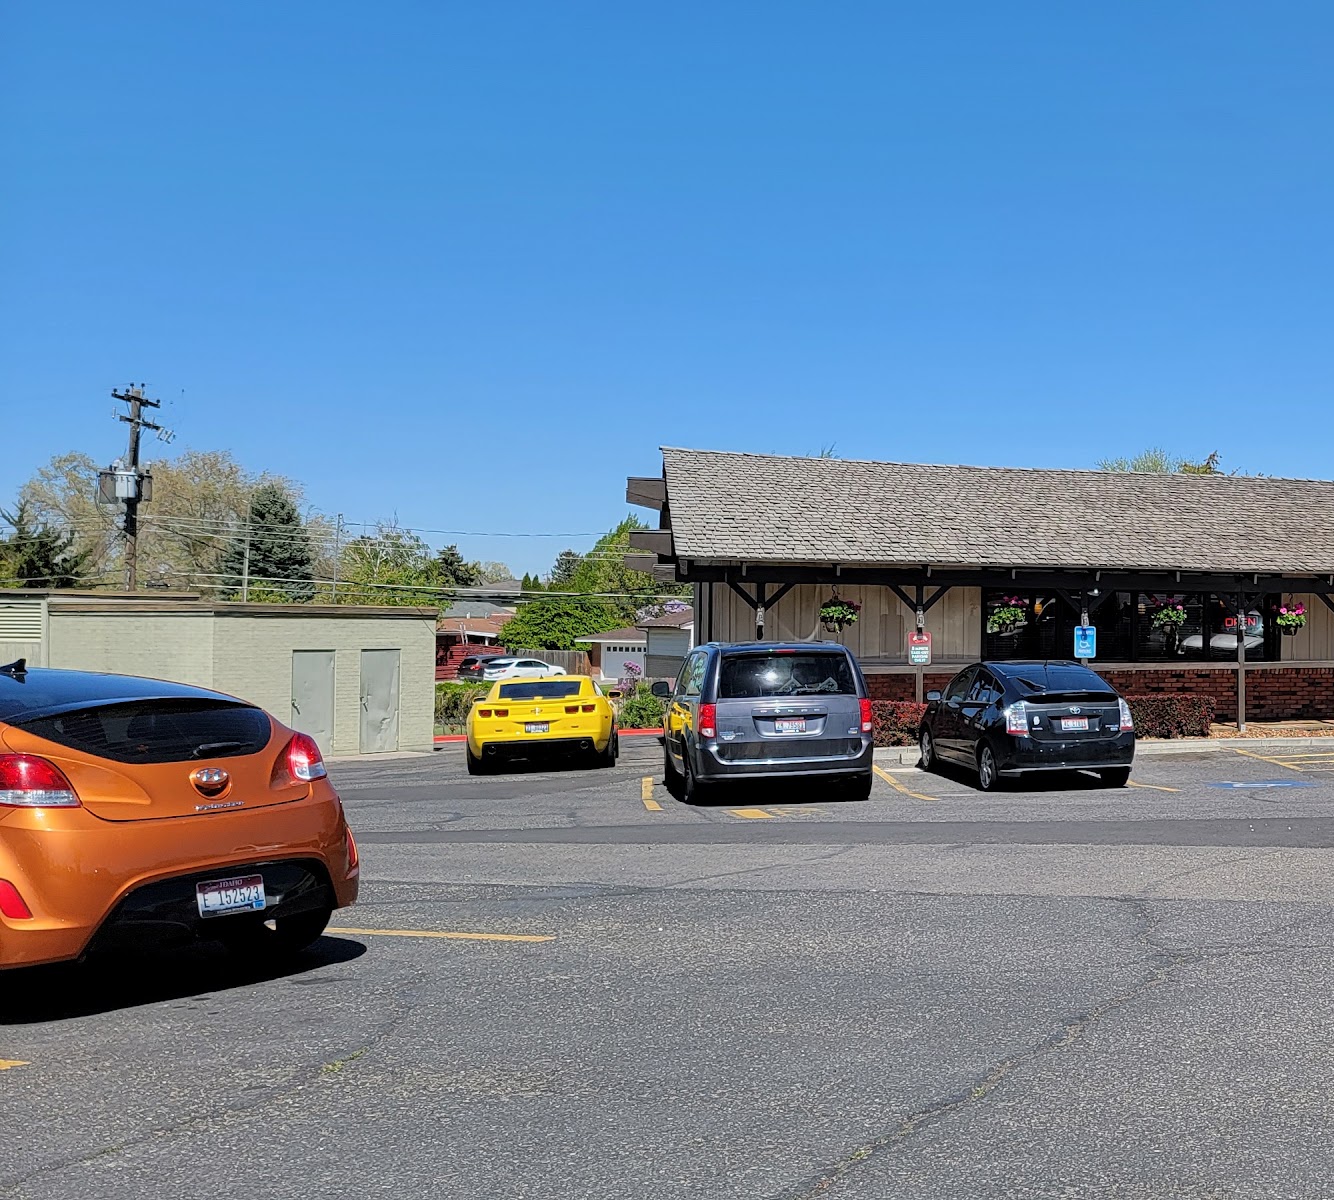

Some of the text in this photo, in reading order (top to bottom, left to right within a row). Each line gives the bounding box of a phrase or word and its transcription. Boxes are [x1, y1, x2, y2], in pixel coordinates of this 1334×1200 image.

[220, 879, 243, 888] IDAHO
[203, 886, 260, 908] E 152523
